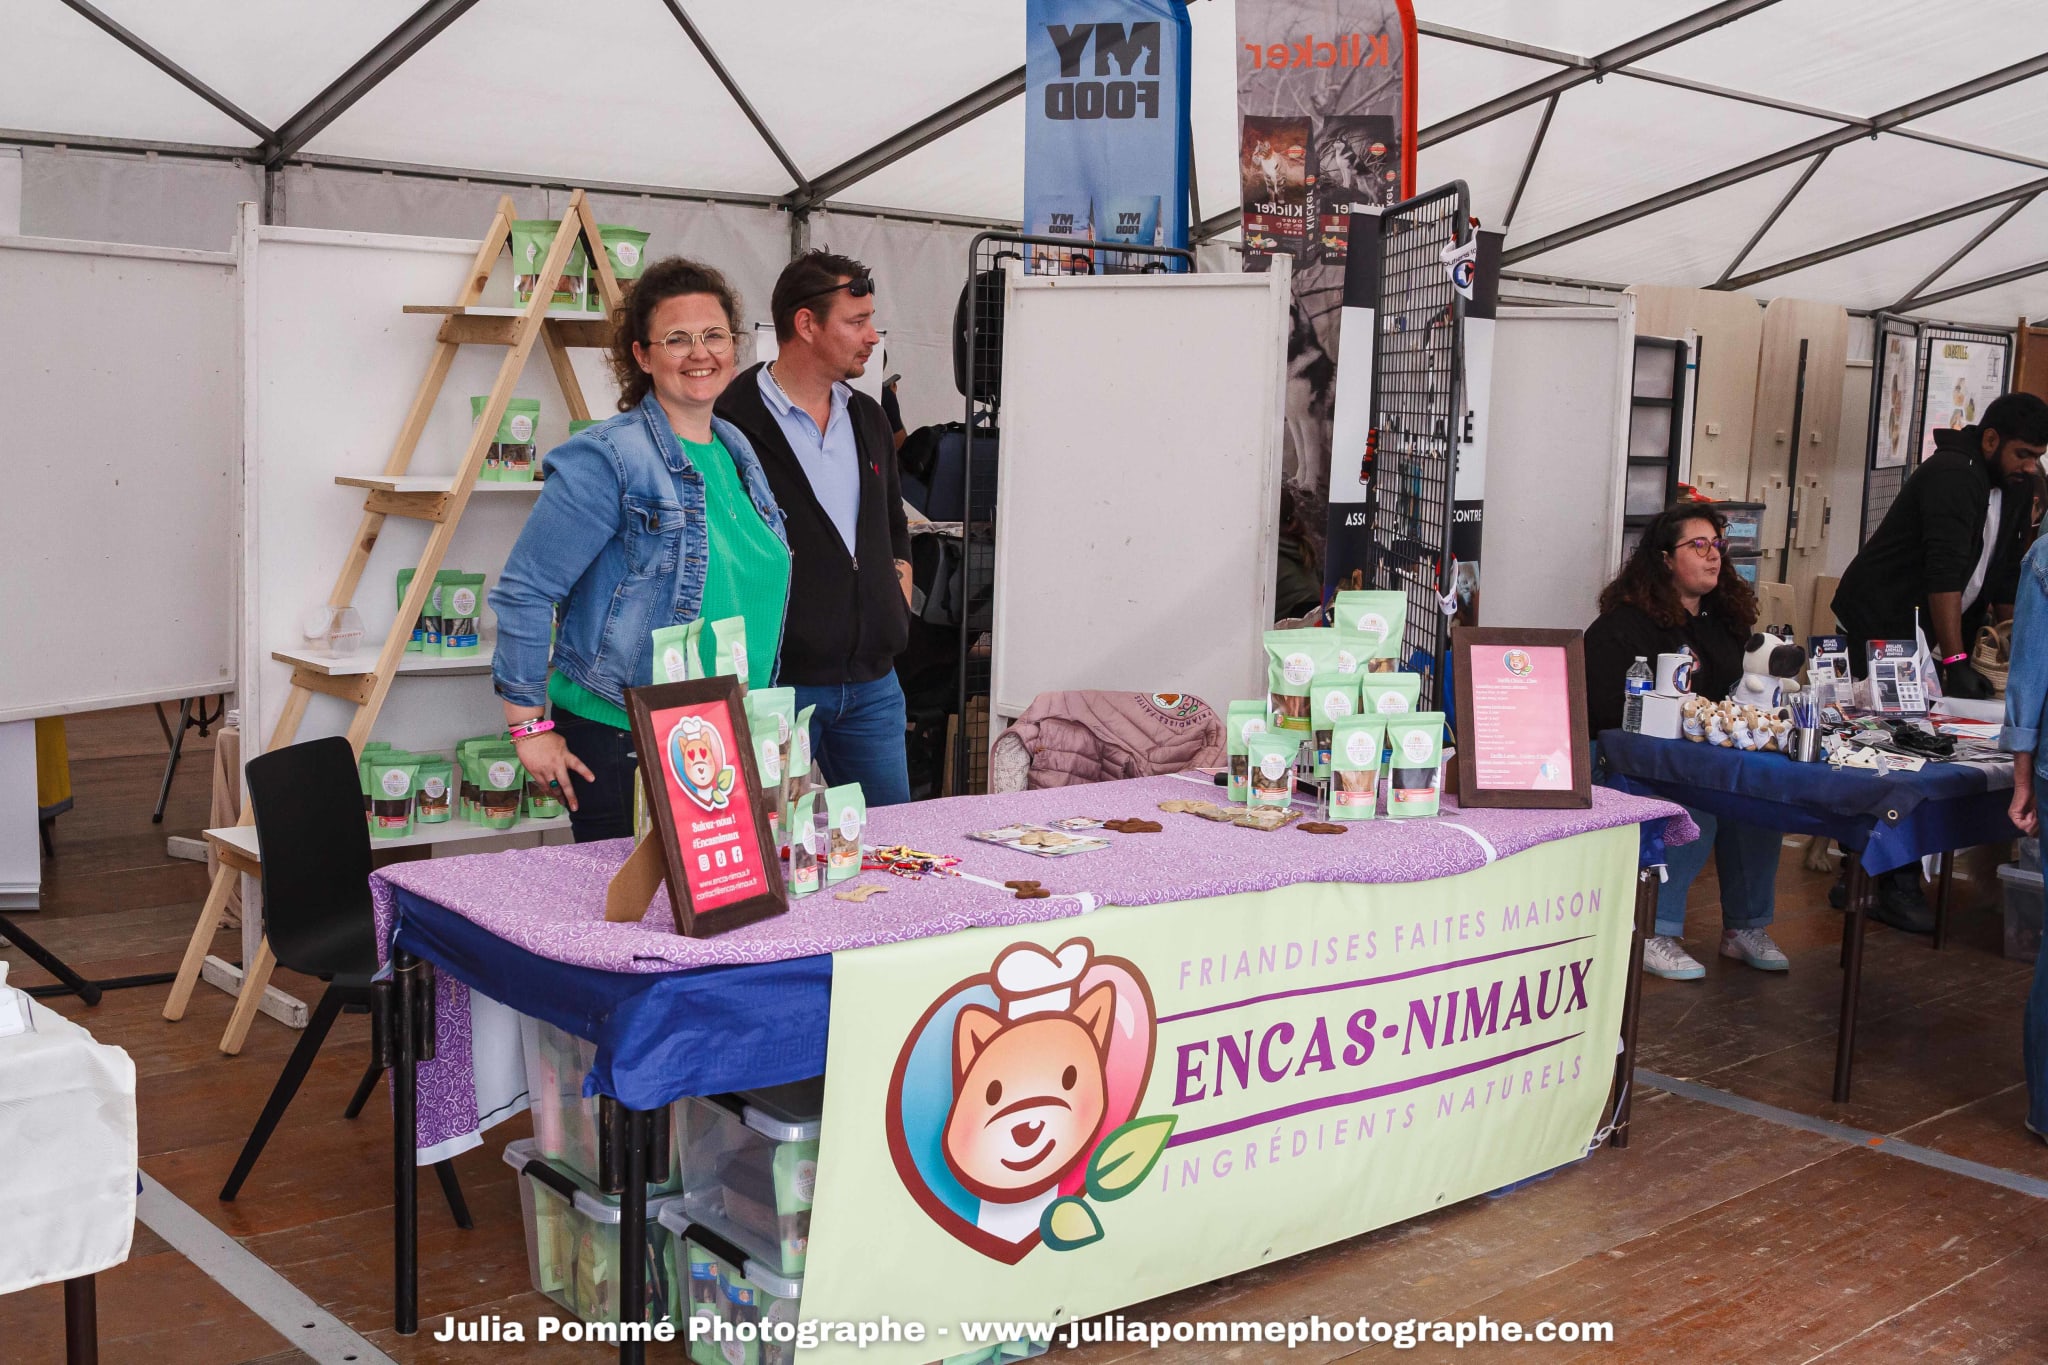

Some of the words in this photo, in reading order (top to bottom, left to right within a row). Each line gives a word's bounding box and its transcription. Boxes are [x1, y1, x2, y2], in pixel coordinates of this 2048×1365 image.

[1179, 931, 1378, 990] FRIANDISES
[1394, 910, 1486, 953] FAITES
[1502, 887, 1602, 932] MAISON
[1171, 957, 1595, 1107] ENCAS-NIMAUX
[1162, 1103, 1415, 1192] INGRÉDIENTS
[1437, 1055, 1583, 1118] NATURELS
